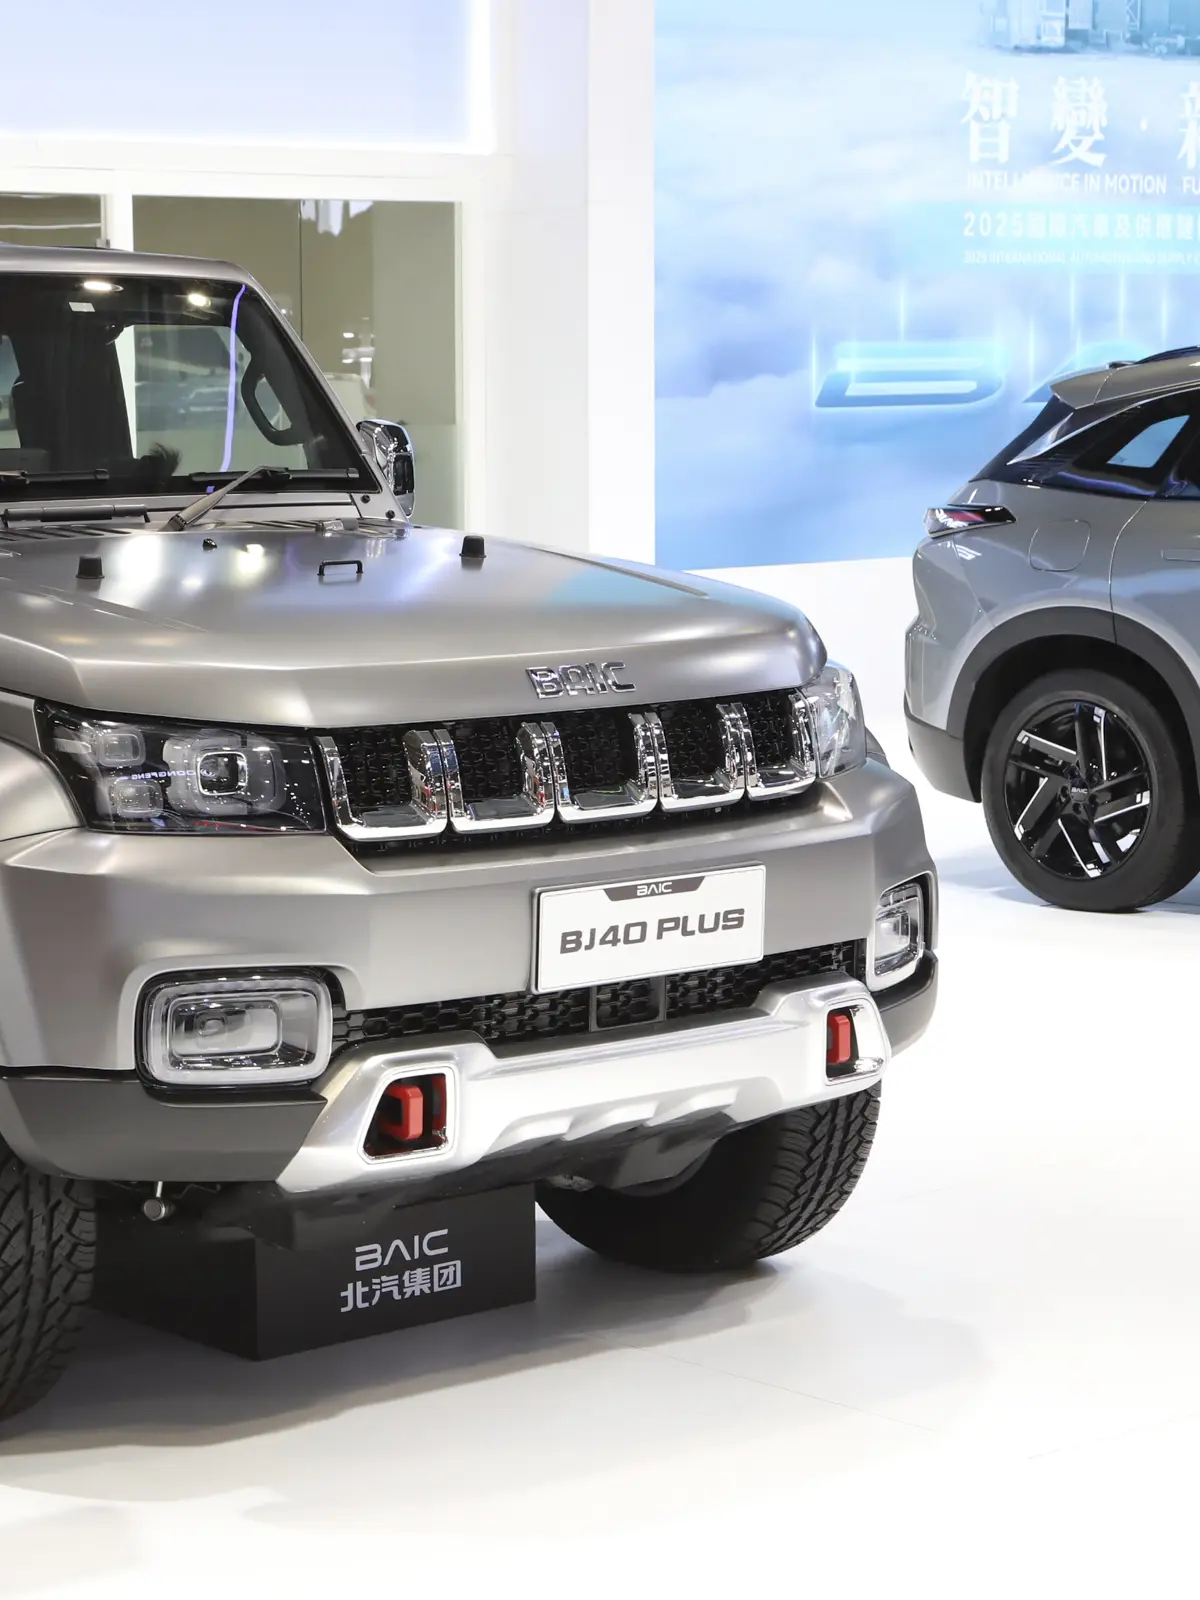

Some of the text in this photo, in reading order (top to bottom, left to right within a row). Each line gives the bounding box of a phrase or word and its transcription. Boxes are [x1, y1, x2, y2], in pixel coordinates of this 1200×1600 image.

[966, 170, 1079, 193] INTELLCE
[1084, 173, 1101, 195] IN
[1104, 174, 1168, 196] MOTION
[963, 211, 1200, 241] 2025汽車及供鏈
[526, 661, 636, 699] BAIC
[637, 882, 672, 896] BAIC
[560, 908, 745, 954] BJ40 PLUS
[355, 1228, 449, 1272] BAIC
[340, 1260, 462, 1313] 北汽集团
